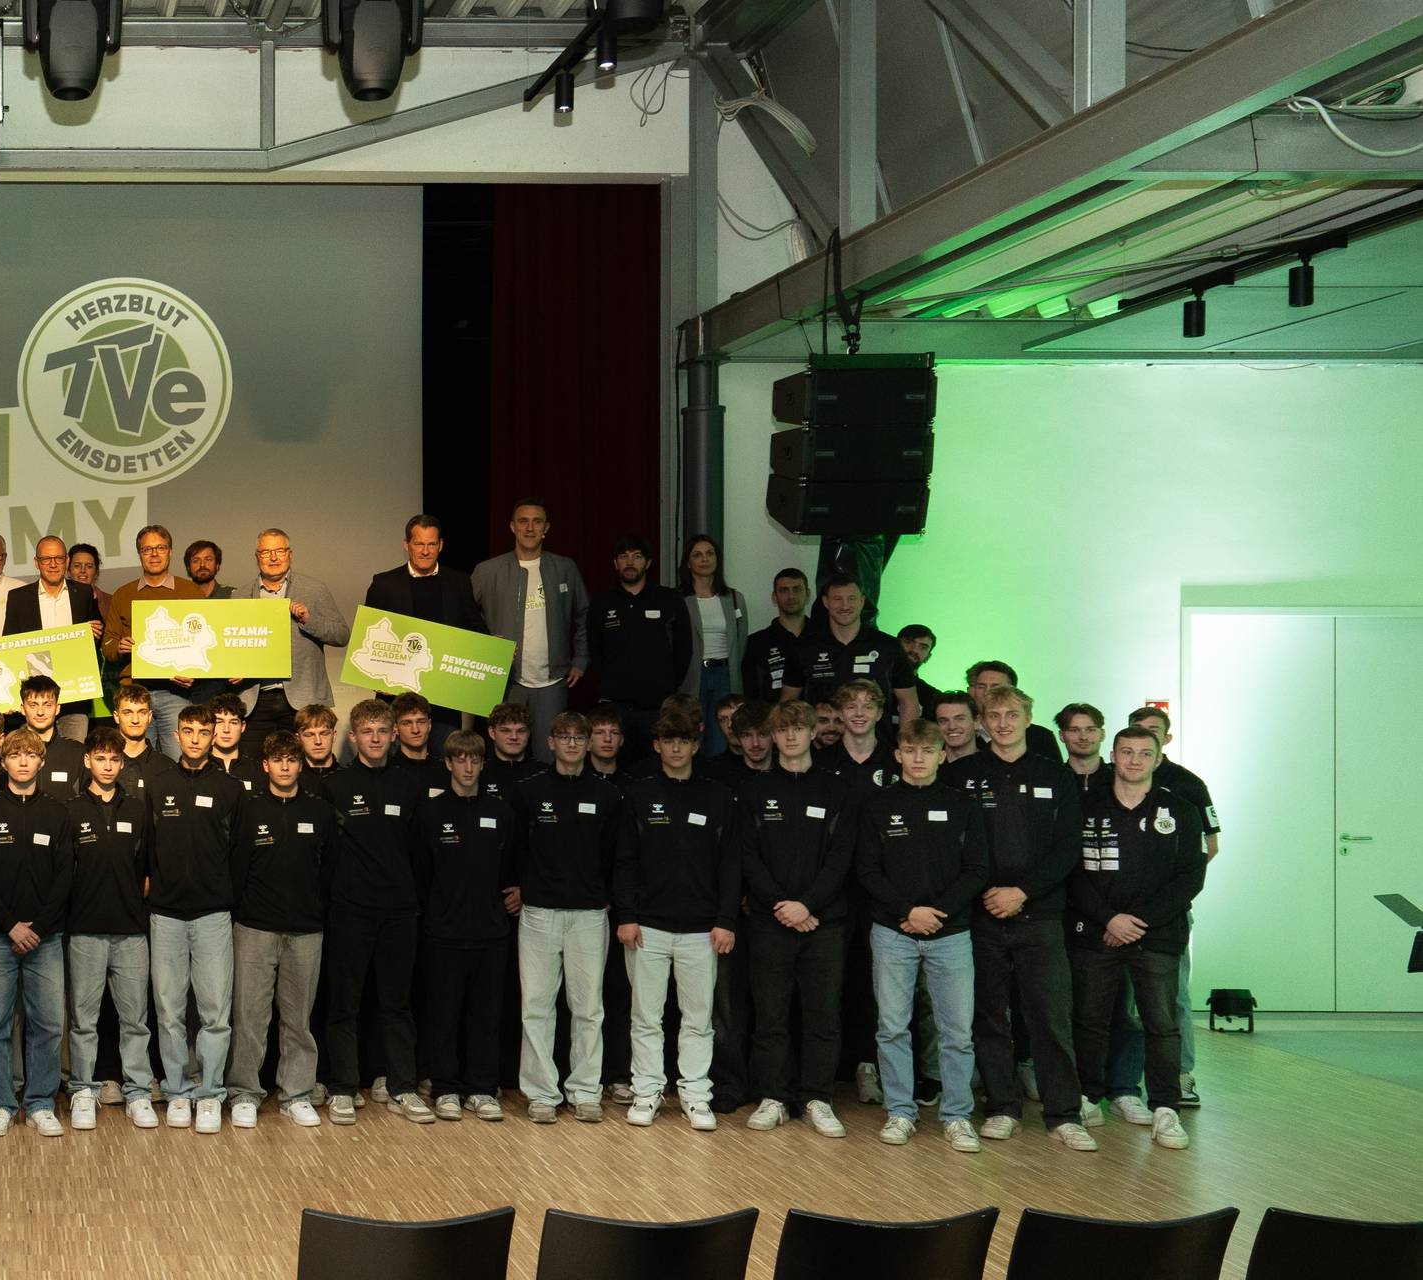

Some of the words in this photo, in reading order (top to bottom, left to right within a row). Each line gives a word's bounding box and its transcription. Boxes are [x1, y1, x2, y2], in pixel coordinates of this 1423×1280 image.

[65, 294, 189, 331] HERZBLUT
[43, 323, 207, 434] TVe
[55, 428, 196, 473] EMSDETTEN
[223, 626, 273, 636] STAMM-
[8, 630, 86, 649] PARTNERSCHAFT
[224, 638, 267, 647] VEREIN
[373, 641, 402, 652] GREEN
[407, 639, 423, 651] TVe
[371, 650, 413, 662] ACADEMY
[439, 663, 486, 681] PARTNER
[441, 655, 507, 676] BEWEGUNGS-
[1076, 922, 1084, 932] 8
